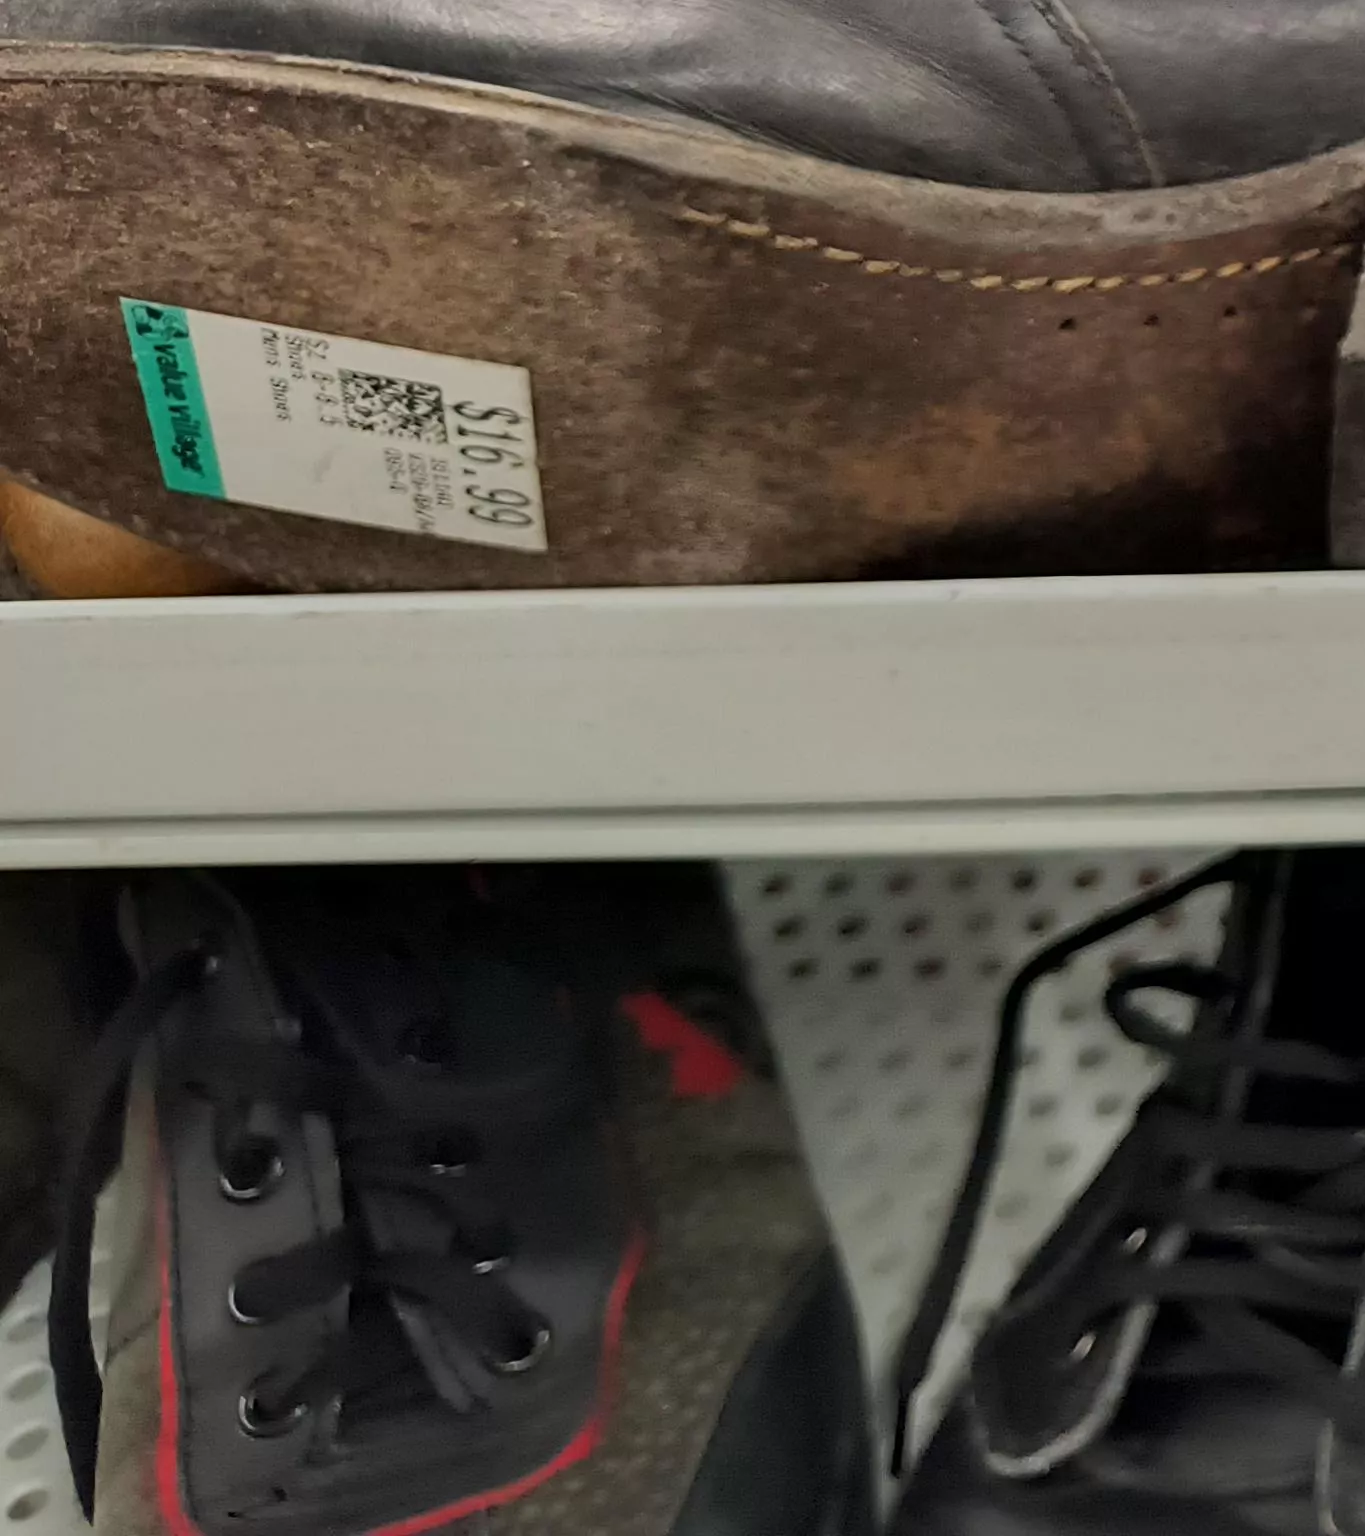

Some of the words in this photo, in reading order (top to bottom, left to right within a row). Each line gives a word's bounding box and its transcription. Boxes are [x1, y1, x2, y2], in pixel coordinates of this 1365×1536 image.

[152, 343, 188, 402] value
[260, 327, 281, 368] Mens
[284, 334, 305, 381] Shoes
[269, 376, 291, 423] Shoes
[167, 404, 205, 478] village
[450, 400, 535, 527] $16.99
